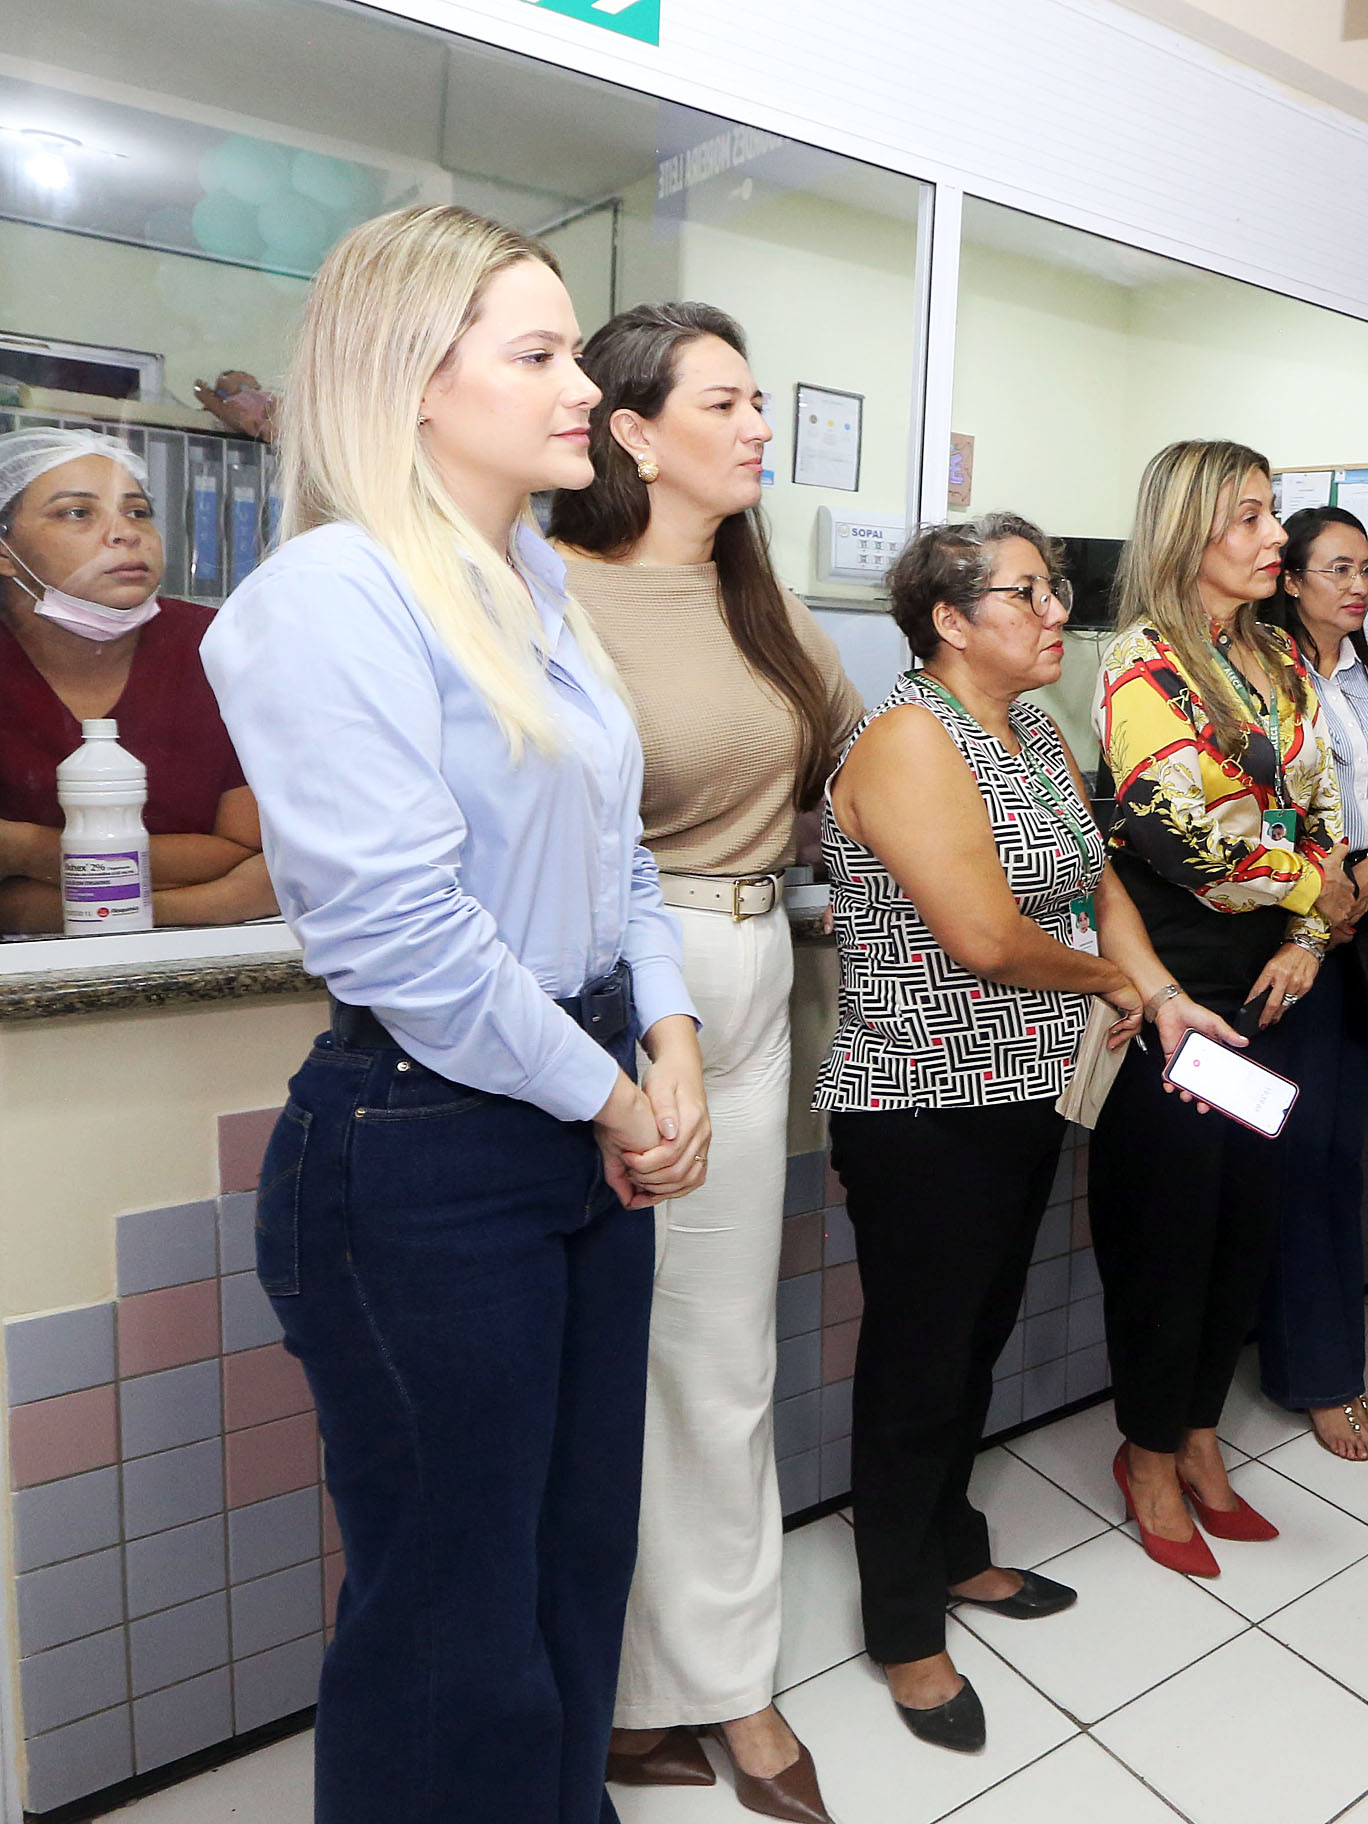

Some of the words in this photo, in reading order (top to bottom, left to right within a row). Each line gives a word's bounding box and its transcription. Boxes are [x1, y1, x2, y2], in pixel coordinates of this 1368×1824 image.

[851, 527, 883, 539] SOPAI
[1223, 667, 1243, 690] ALECE
[1270, 726, 1279, 750] ALECE
